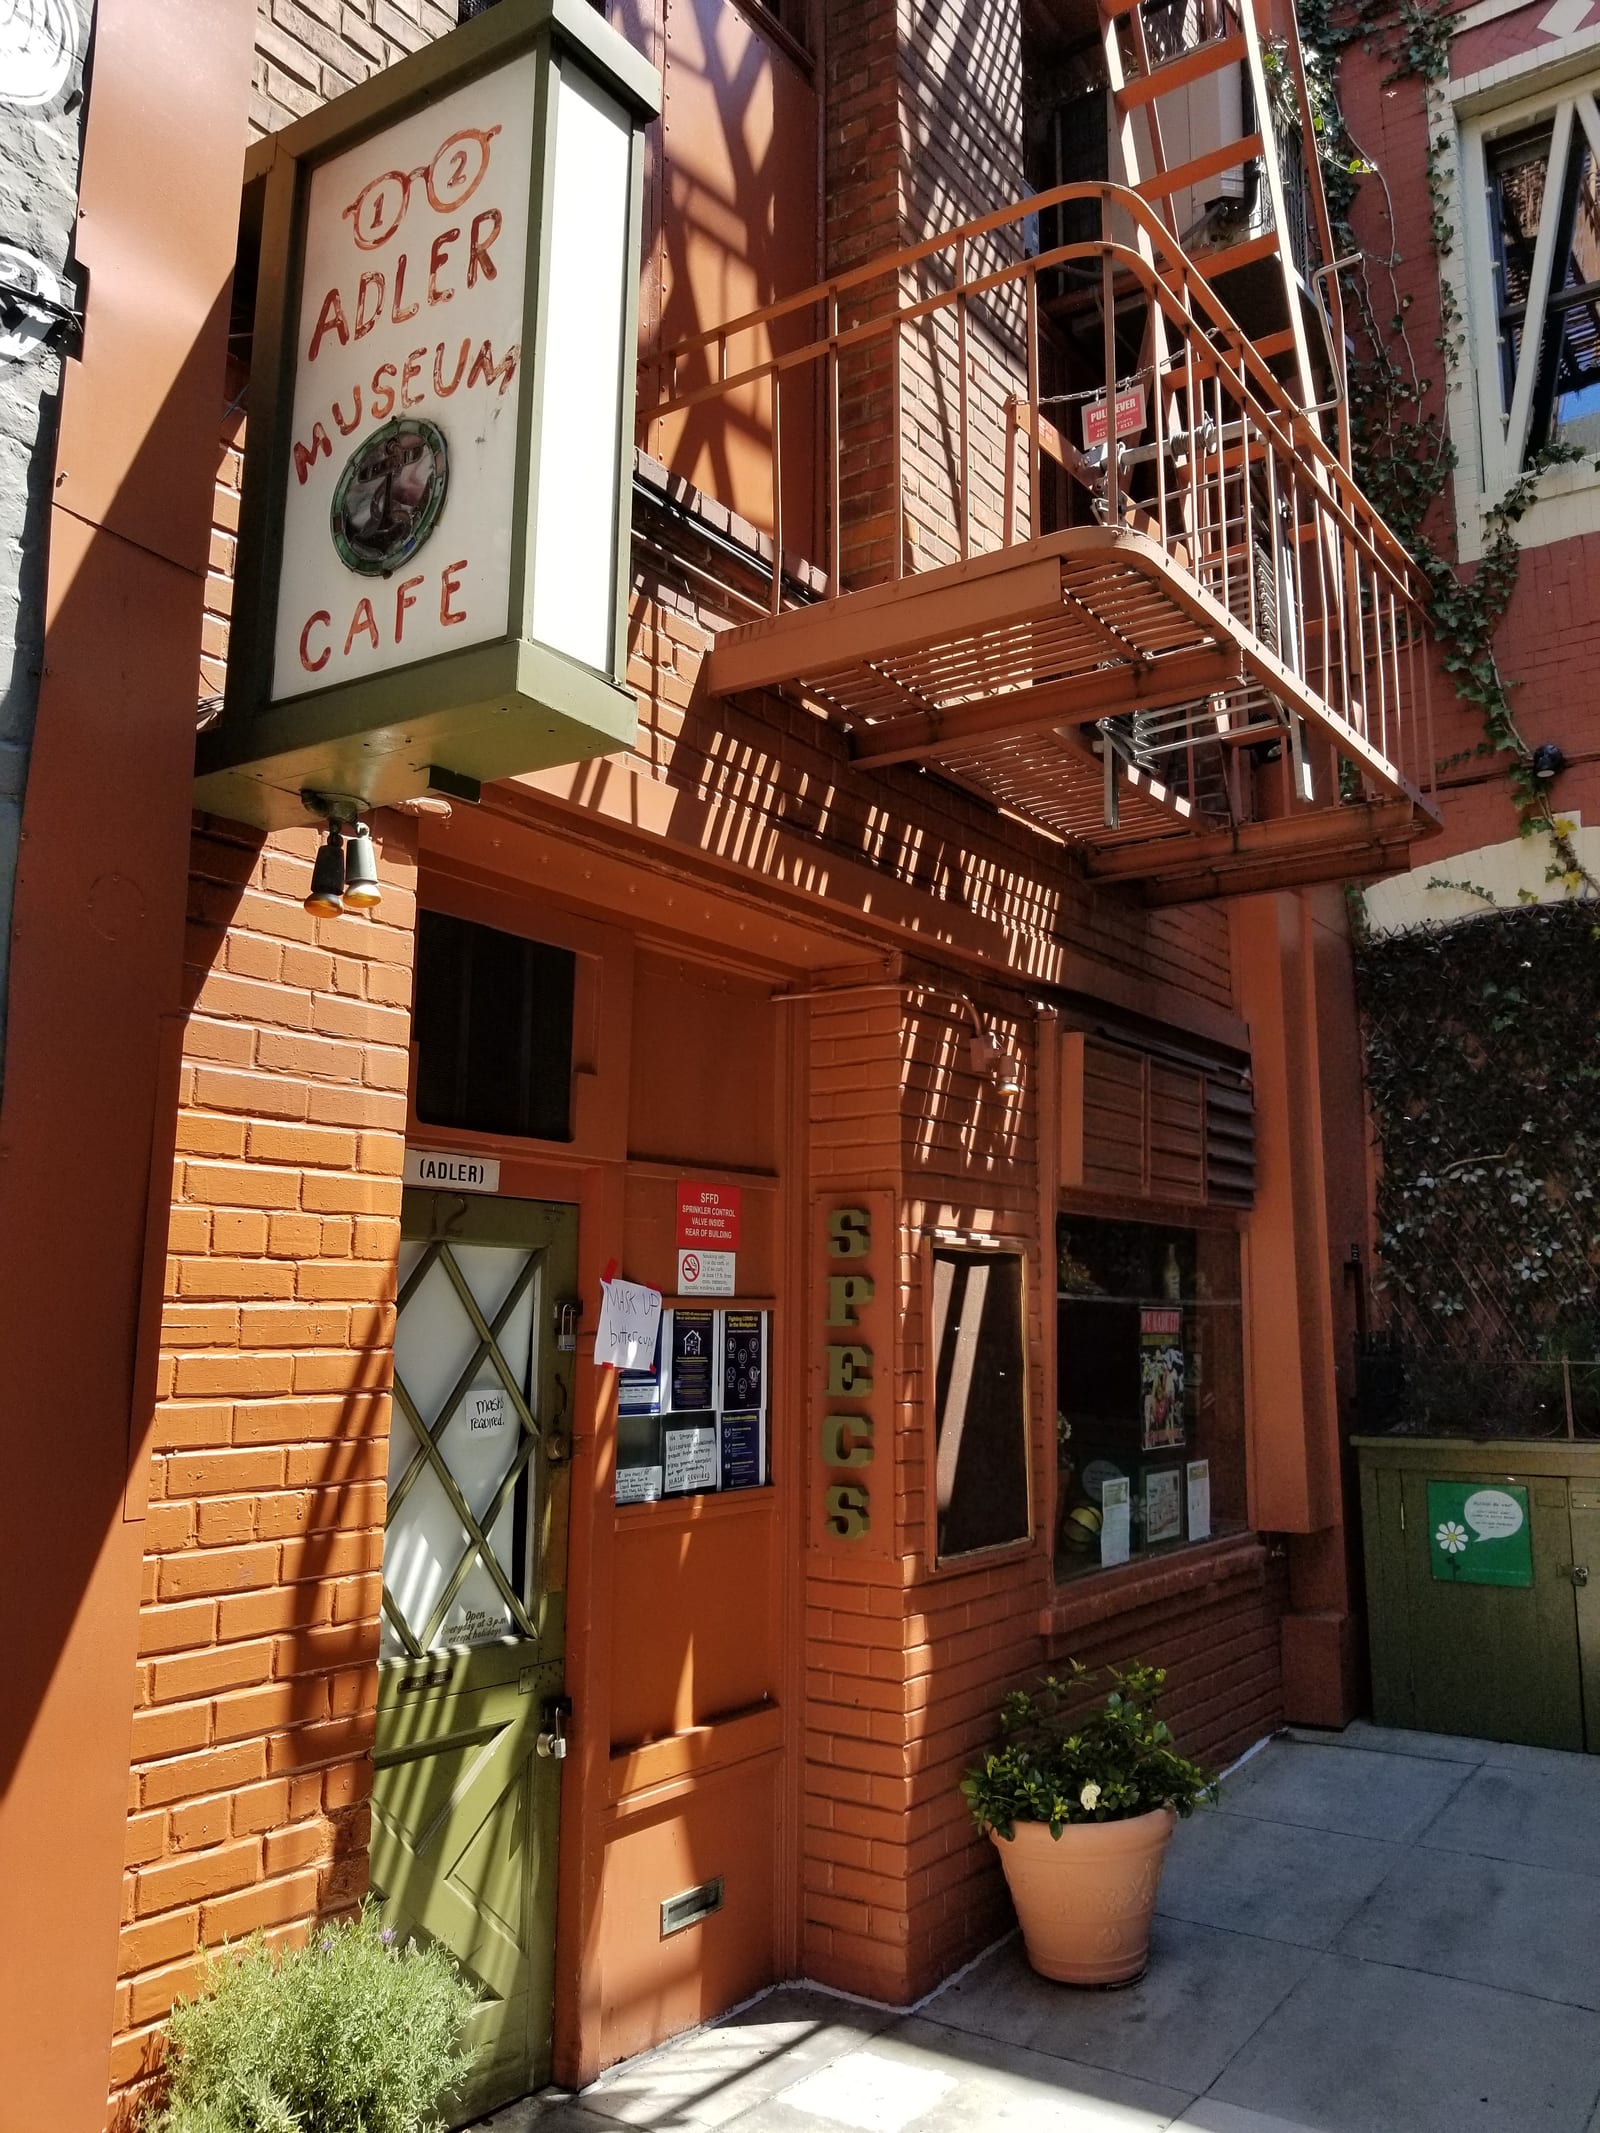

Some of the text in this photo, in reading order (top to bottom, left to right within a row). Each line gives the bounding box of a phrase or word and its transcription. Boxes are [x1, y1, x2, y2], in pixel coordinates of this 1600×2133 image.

[308, 208, 502, 361] ADLER
[294, 338, 520, 485] MUSEUM
[299, 559, 468, 672] CAFE
[420, 1159, 484, 1184] (ADLER)
[700, 1192, 719, 1204] SFFD
[682, 1205, 736, 1217] SPRINKLER CONTROL
[691, 1217, 725, 1228] VALVE INSIDE
[685, 1228, 732, 1239] REAR OF BUILDING
[606, 1286, 659, 1317] MASK UP
[821, 1208, 874, 1540] SPECS
[465, 1611, 485, 1622] Open
[477, 1618, 485, 1628] at
[448, 1627, 502, 1643] except holidays
